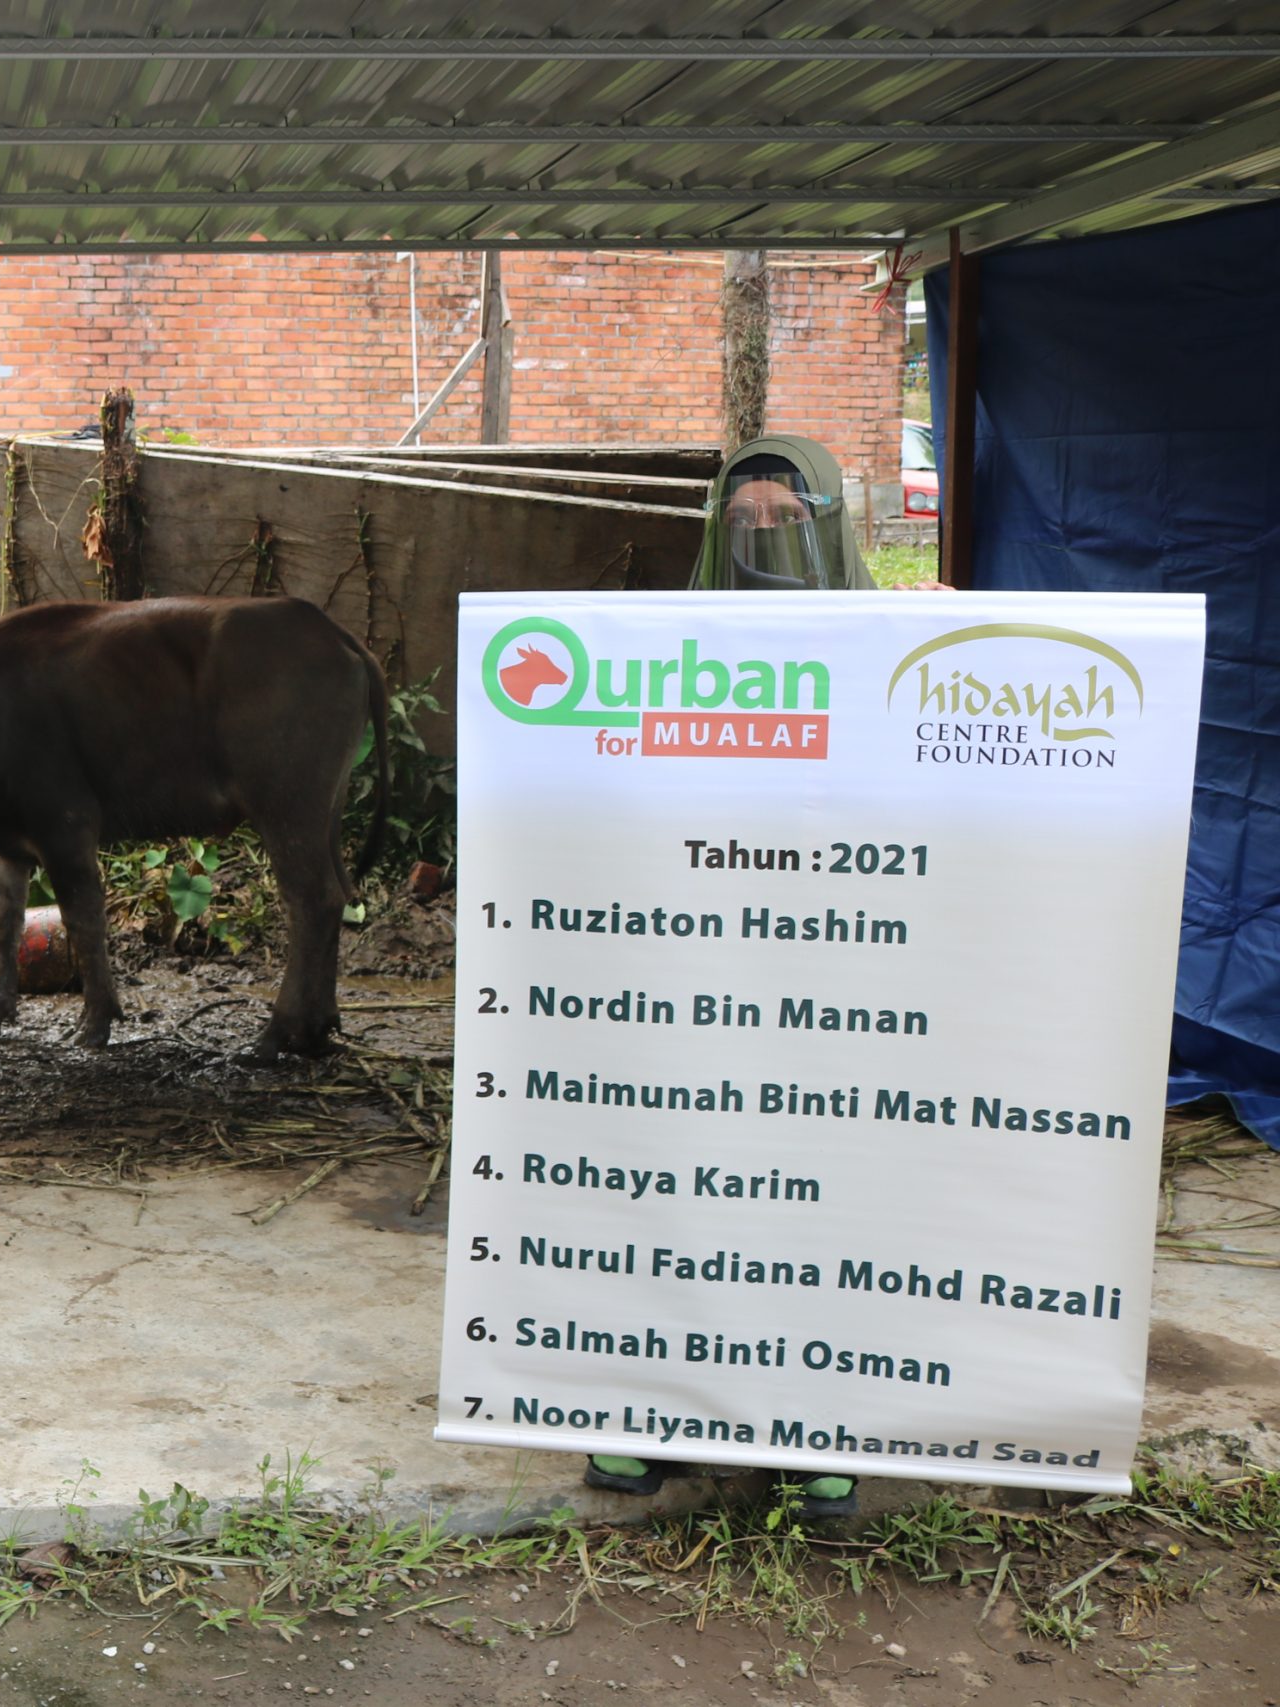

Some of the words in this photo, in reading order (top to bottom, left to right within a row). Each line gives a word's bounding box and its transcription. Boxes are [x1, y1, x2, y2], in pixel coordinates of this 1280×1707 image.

[595, 729, 638, 756] for
[652, 723, 819, 747] MUALAF
[916, 724, 1028, 744] CENTRE
[916, 745, 1116, 768] FOUNDATION
[685, 840, 800, 871] Tahun
[481, 902, 512, 930] 1.
[530, 899, 722, 939] Ruziaton
[741, 906, 908, 945] Hashim
[478, 988, 510, 1015] 2.
[529, 986, 674, 1025] Nordin
[692, 995, 760, 1029] Bin
[778, 998, 929, 1036] Manan
[476, 1072, 508, 1099] 3.
[525, 1069, 743, 1114] Maimunah
[759, 1082, 859, 1119] Binti
[874, 1089, 956, 1126] Mat
[971, 1096, 1131, 1141] Nassan
[472, 1155, 504, 1181] 4.
[522, 1153, 676, 1200] Rohaya
[694, 1166, 820, 1202] Karim
[470, 1236, 501, 1263] 5.
[519, 1235, 635, 1275] Nurul
[652, 1248, 820, 1288] Fadiana
[838, 1259, 962, 1301] Mohd
[979, 1275, 1122, 1320] Razali
[466, 1317, 498, 1344] 6.
[515, 1318, 668, 1359] Salmah
[685, 1333, 786, 1368] Binti
[801, 1340, 951, 1387] Osman
[462, 1396, 494, 1421] 7.
[512, 1396, 609, 1431] Noor
[623, 1408, 756, 1444] Liyana
[769, 1419, 978, 1460] Mohamad
[992, 1442, 1101, 1470] Saad
